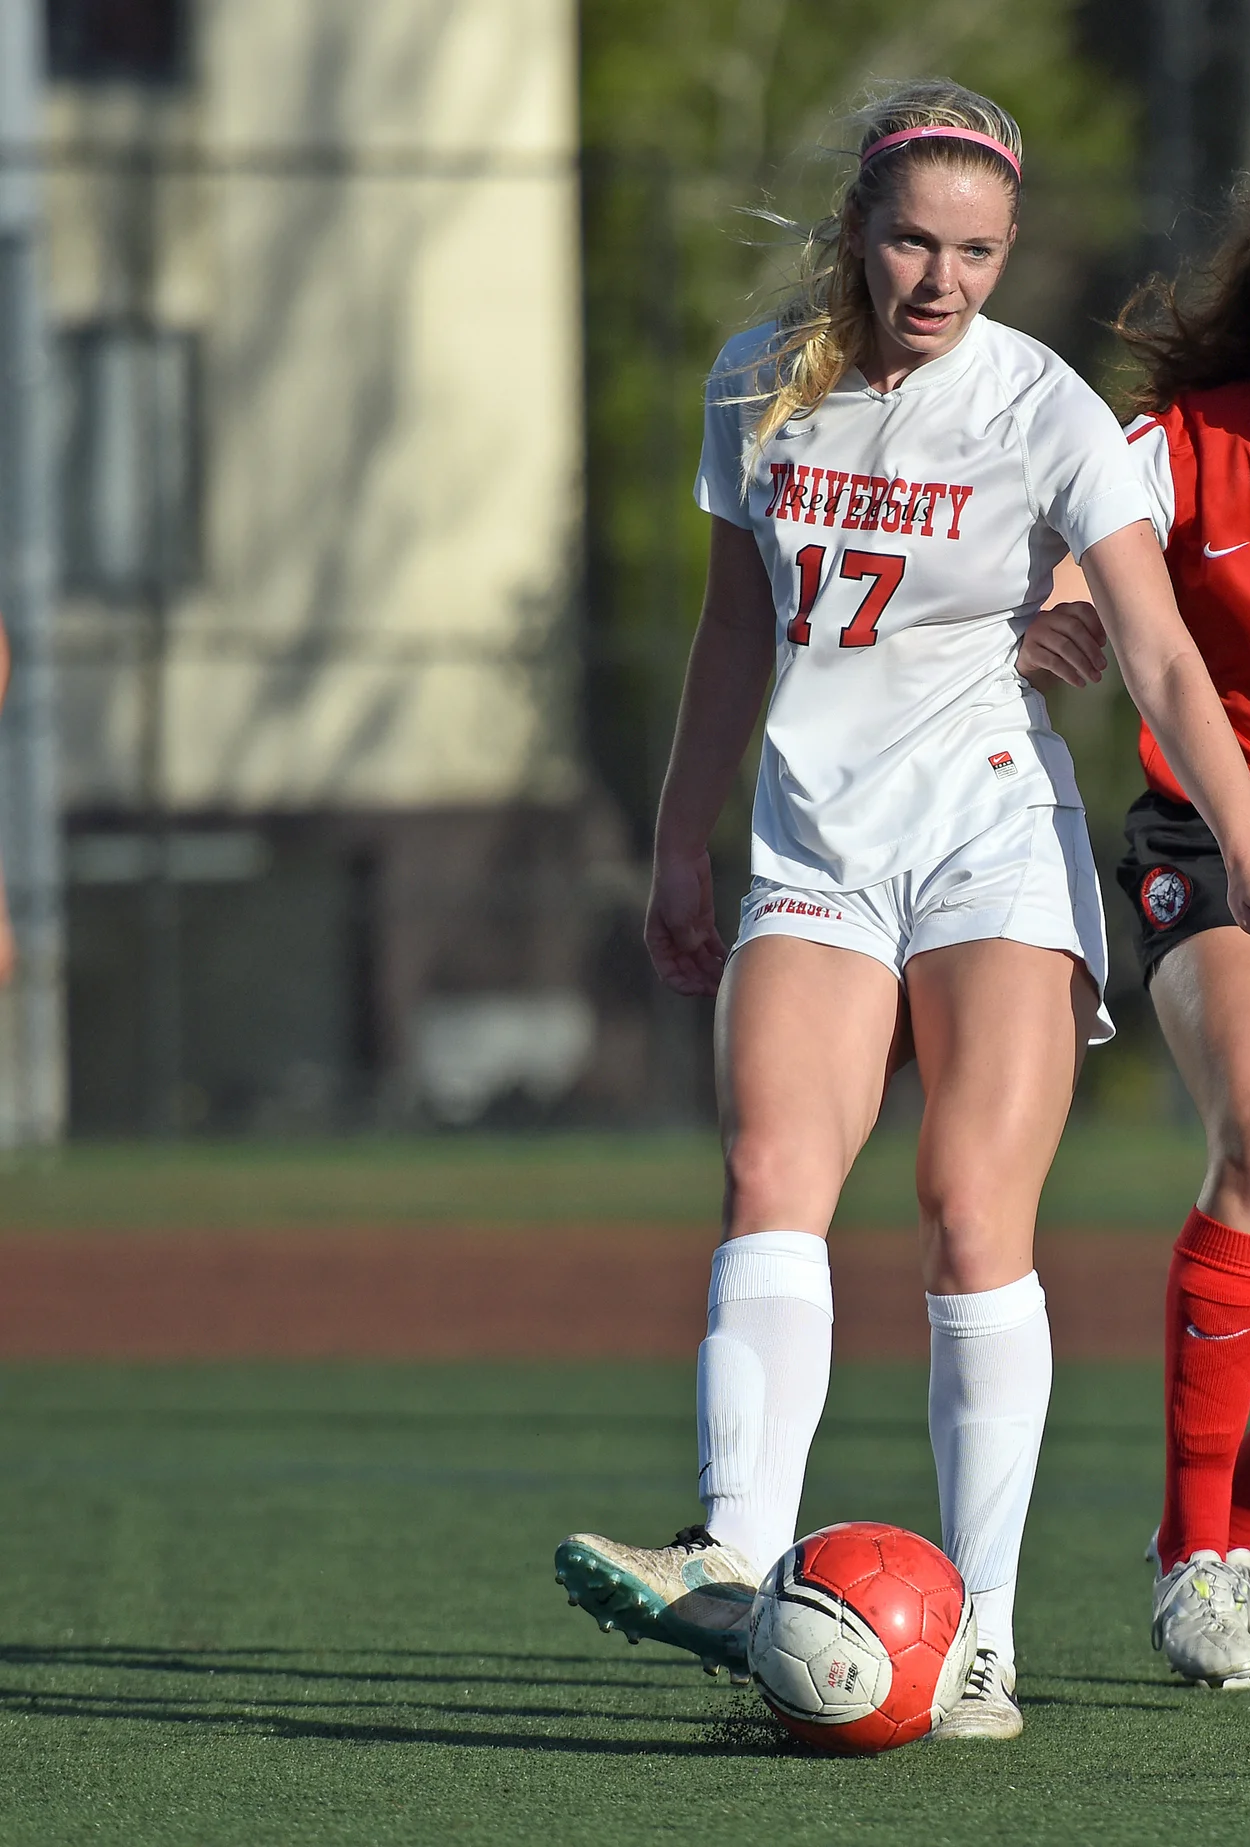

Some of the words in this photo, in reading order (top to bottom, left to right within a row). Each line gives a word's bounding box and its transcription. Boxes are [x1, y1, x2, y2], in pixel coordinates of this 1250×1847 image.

[786, 484, 850, 514] Red
[851, 494, 932, 522] Devils
[787, 543, 907, 648] 17
[828, 1659, 841, 1688] APEX
